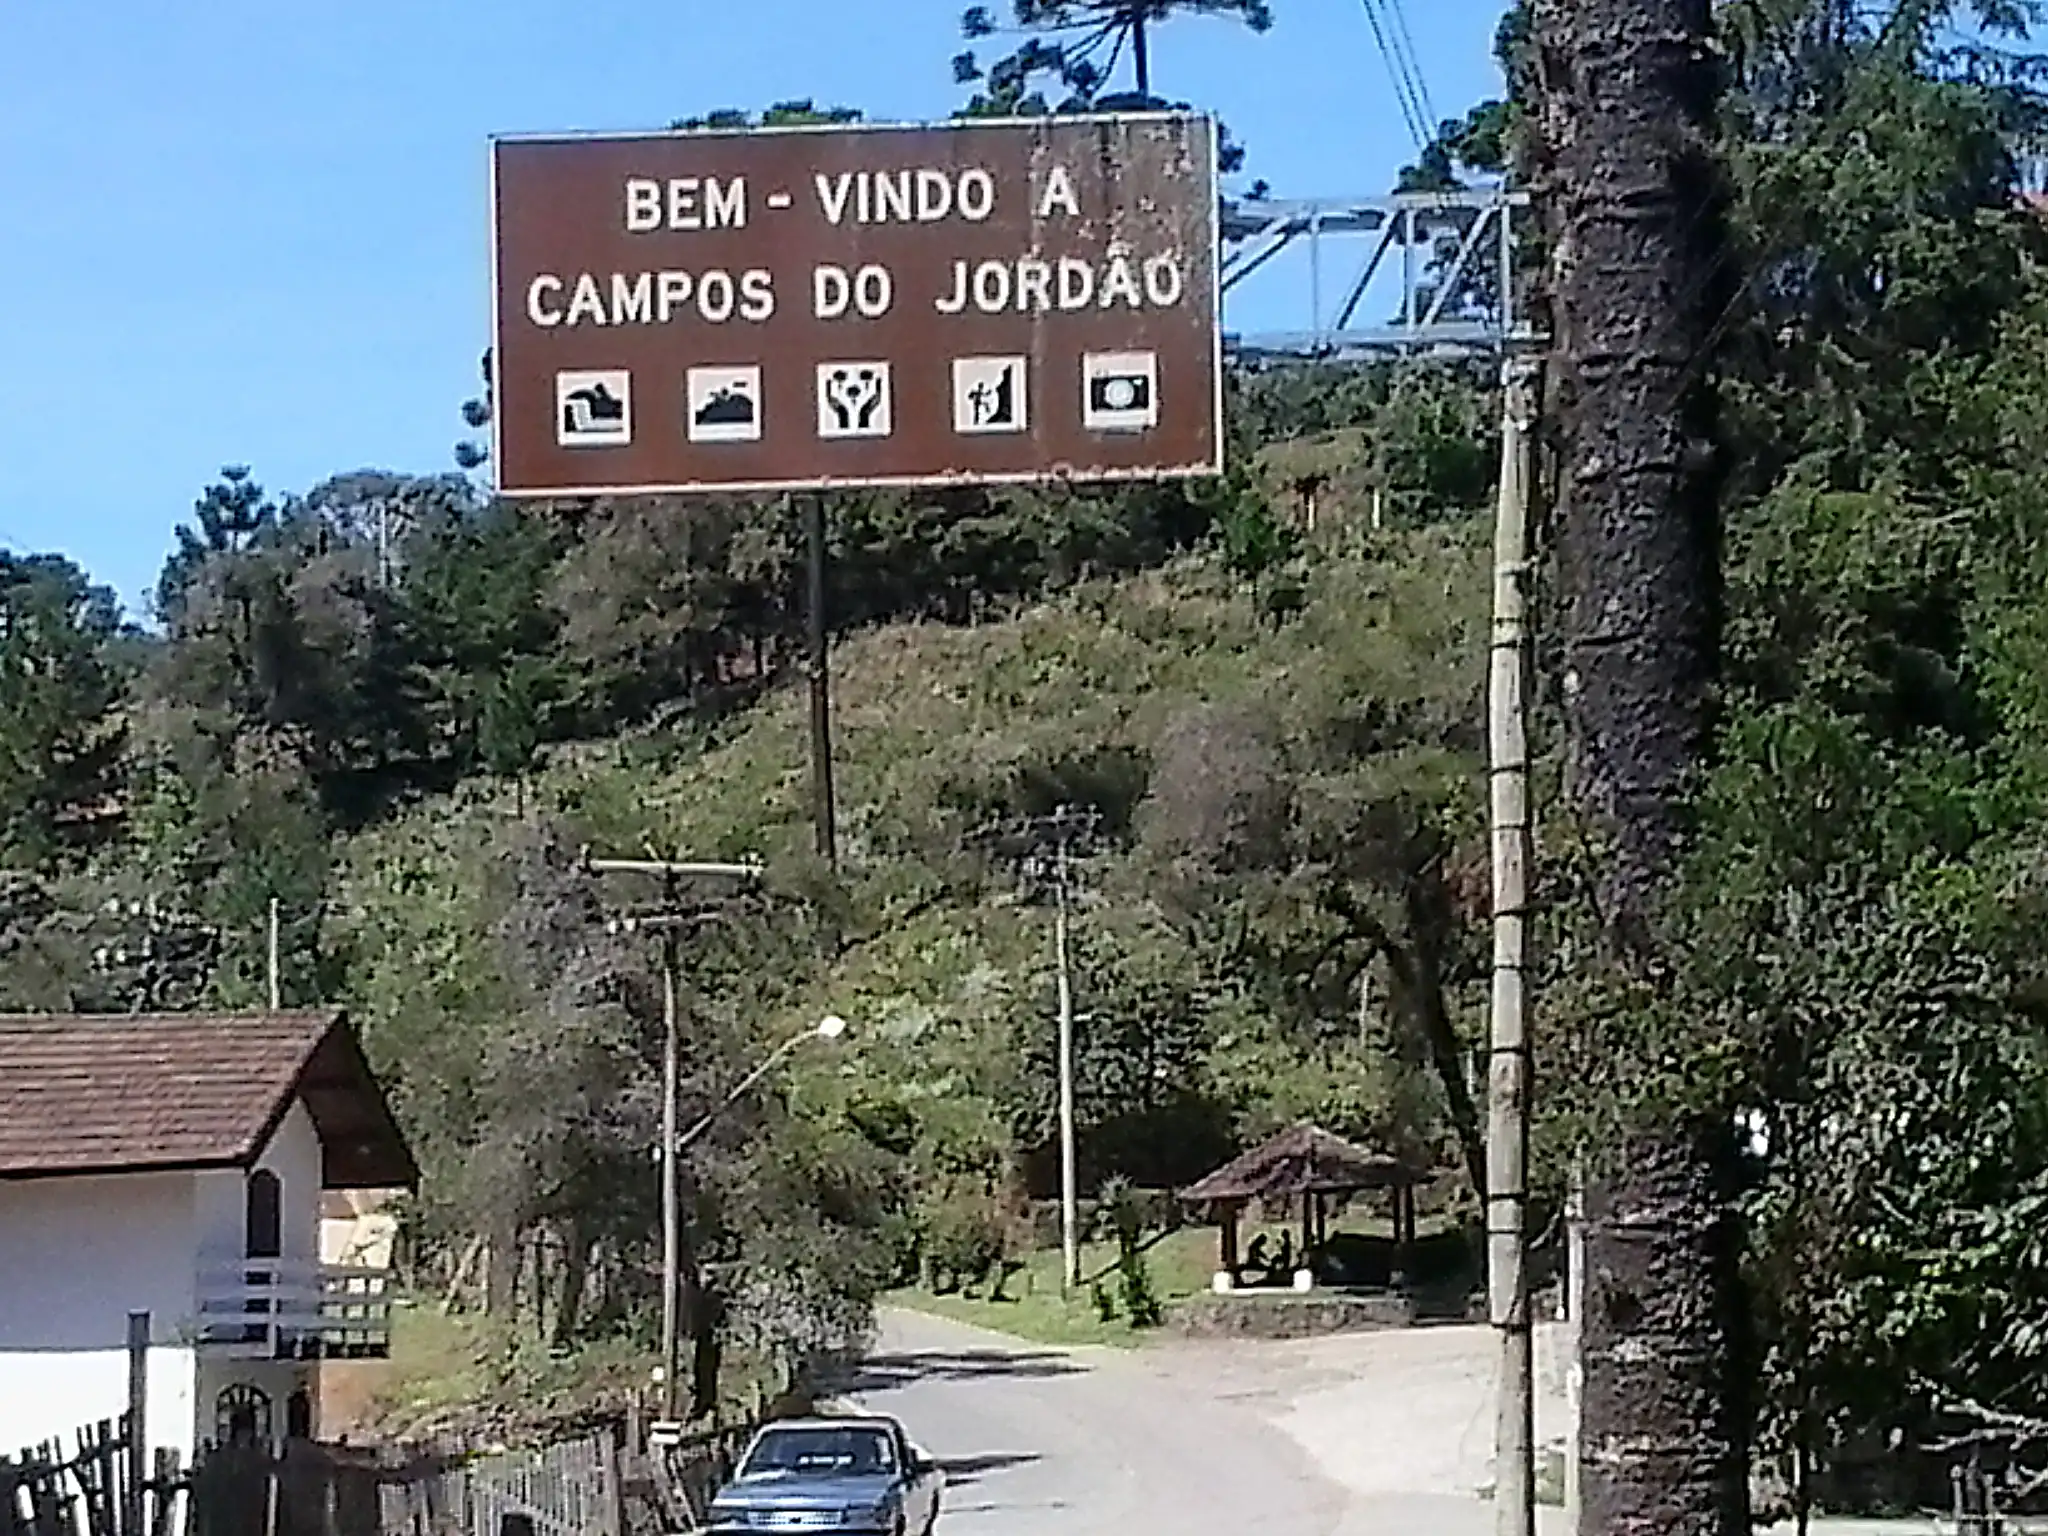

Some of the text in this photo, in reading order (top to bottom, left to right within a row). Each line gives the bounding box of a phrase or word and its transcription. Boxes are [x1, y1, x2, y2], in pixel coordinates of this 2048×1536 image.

[626, 177, 747, 231] BEM
[815, 169, 995, 225] VINDO
[1039, 166, 1080, 218] A
[526, 242, 1184, 327] CAMPOS DO JORDÃO
